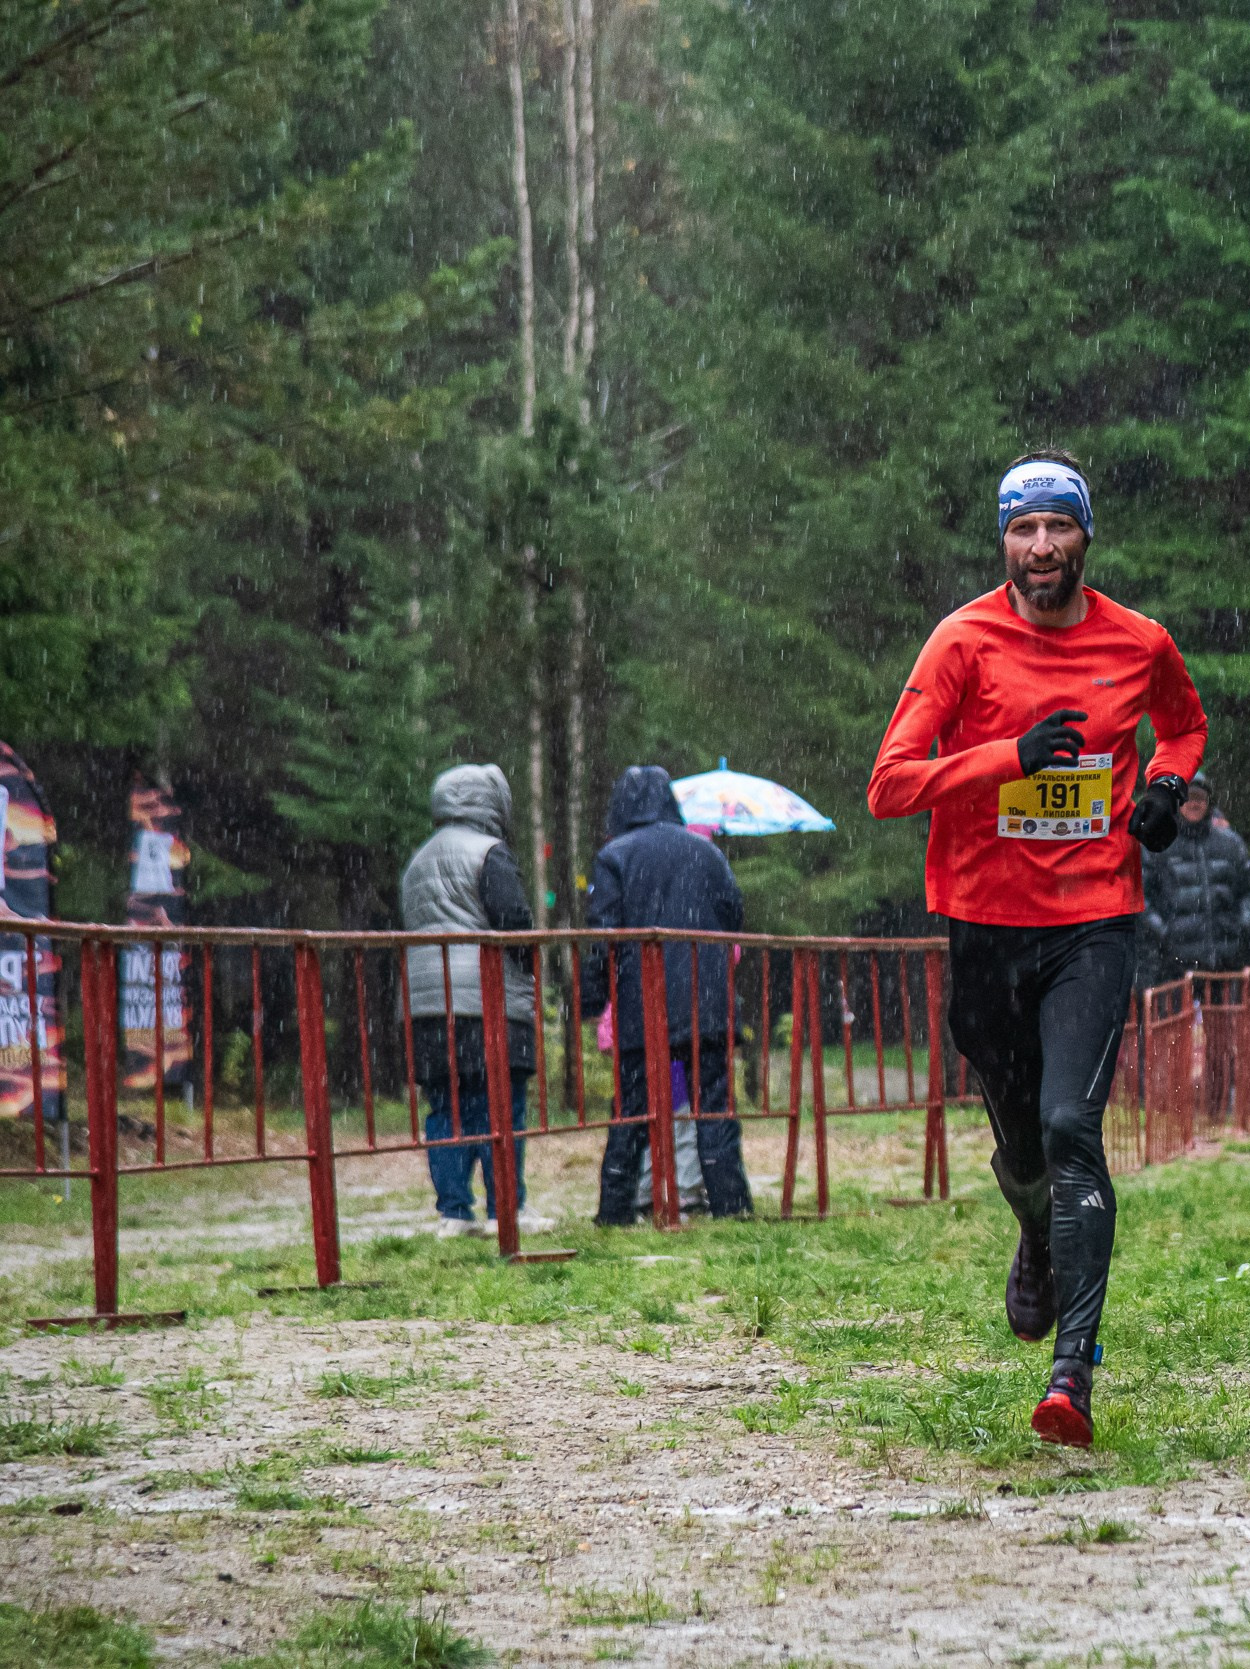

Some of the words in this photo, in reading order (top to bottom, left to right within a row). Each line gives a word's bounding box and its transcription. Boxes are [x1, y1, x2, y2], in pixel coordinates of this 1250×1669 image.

[1023, 481, 1054, 490] RACE
[1033, 773, 1075, 781] УРАЛЬСКИЙ
[1076, 773, 1101, 781] ВУЛКАН
[1036, 783, 1080, 809] 191
